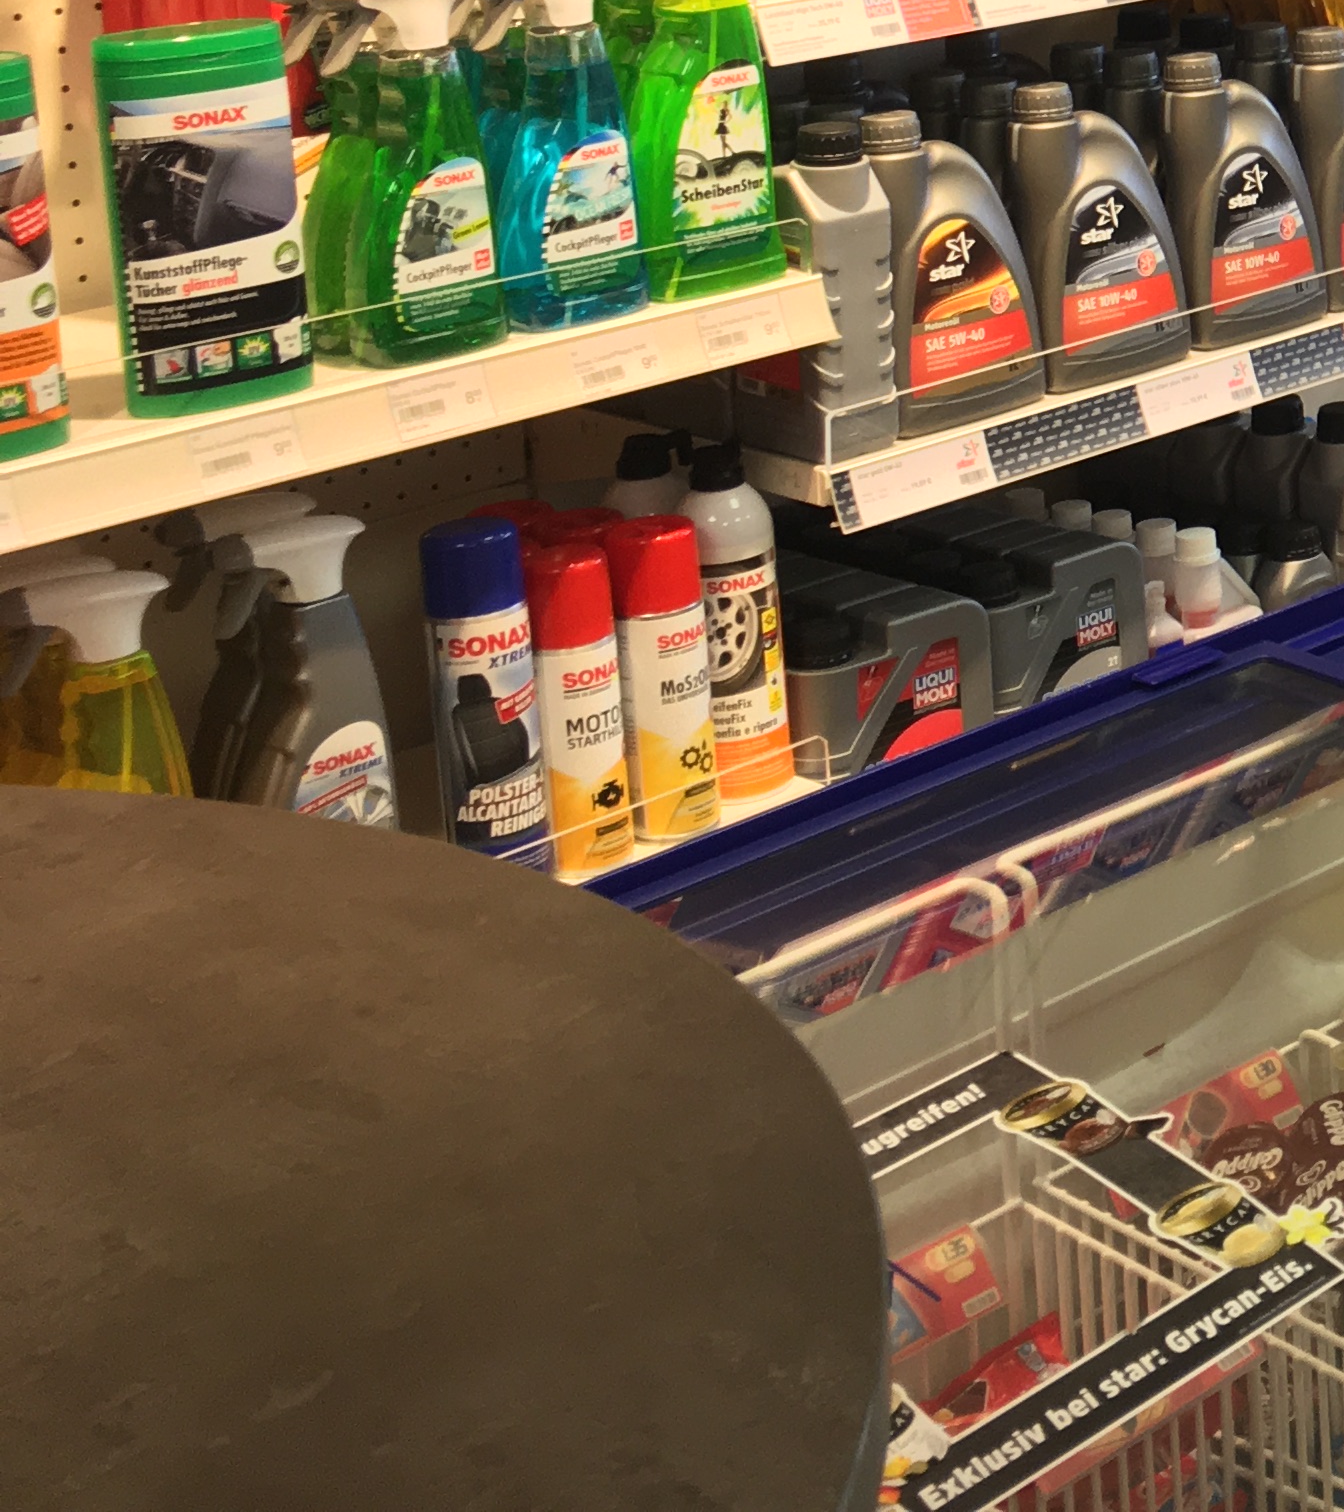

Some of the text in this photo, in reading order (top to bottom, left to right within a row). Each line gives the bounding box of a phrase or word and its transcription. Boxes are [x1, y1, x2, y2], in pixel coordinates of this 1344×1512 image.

[710, 71, 751, 87] SONAX
[172, 106, 248, 131] SONAX
[580, 144, 621, 162] SONAX
[433, 168, 476, 188] SONAX
[680, 176, 764, 205] ScheibenStar
[1228, 193, 1259, 210] star
[554, 231, 618, 254] CockpitPfleger
[1080, 227, 1114, 246] star
[134, 254, 248, 282] KunststoffPflege-
[406, 260, 473, 285] CockpitPfleger
[928, 263, 965, 282] star
[1224, 251, 1280, 274] SAE 10W-40
[134, 270, 239, 299] Tücher glänzend
[1078, 289, 1138, 313] SAE 10W-40
[925, 328, 985, 352] SAE 5W-40
[706, 570, 767, 596] SONAX
[1077, 607, 1115, 630] LIQUI
[447, 618, 530, 659] SONAX
[657, 621, 705, 651] SONAX
[1077, 620, 1117, 647] MOLY
[562, 658, 619, 689] SONAX
[914, 667, 956, 693] LIQUI
[914, 683, 957, 710] MOLY
[312, 741, 377, 776] SONAX
[339, 755, 386, 778] XTREME
[860, 1082, 988, 1158] ugreifen!
[916, 1259, 1315, 1512] Exklusiv bei star: Grycan-Eis.
